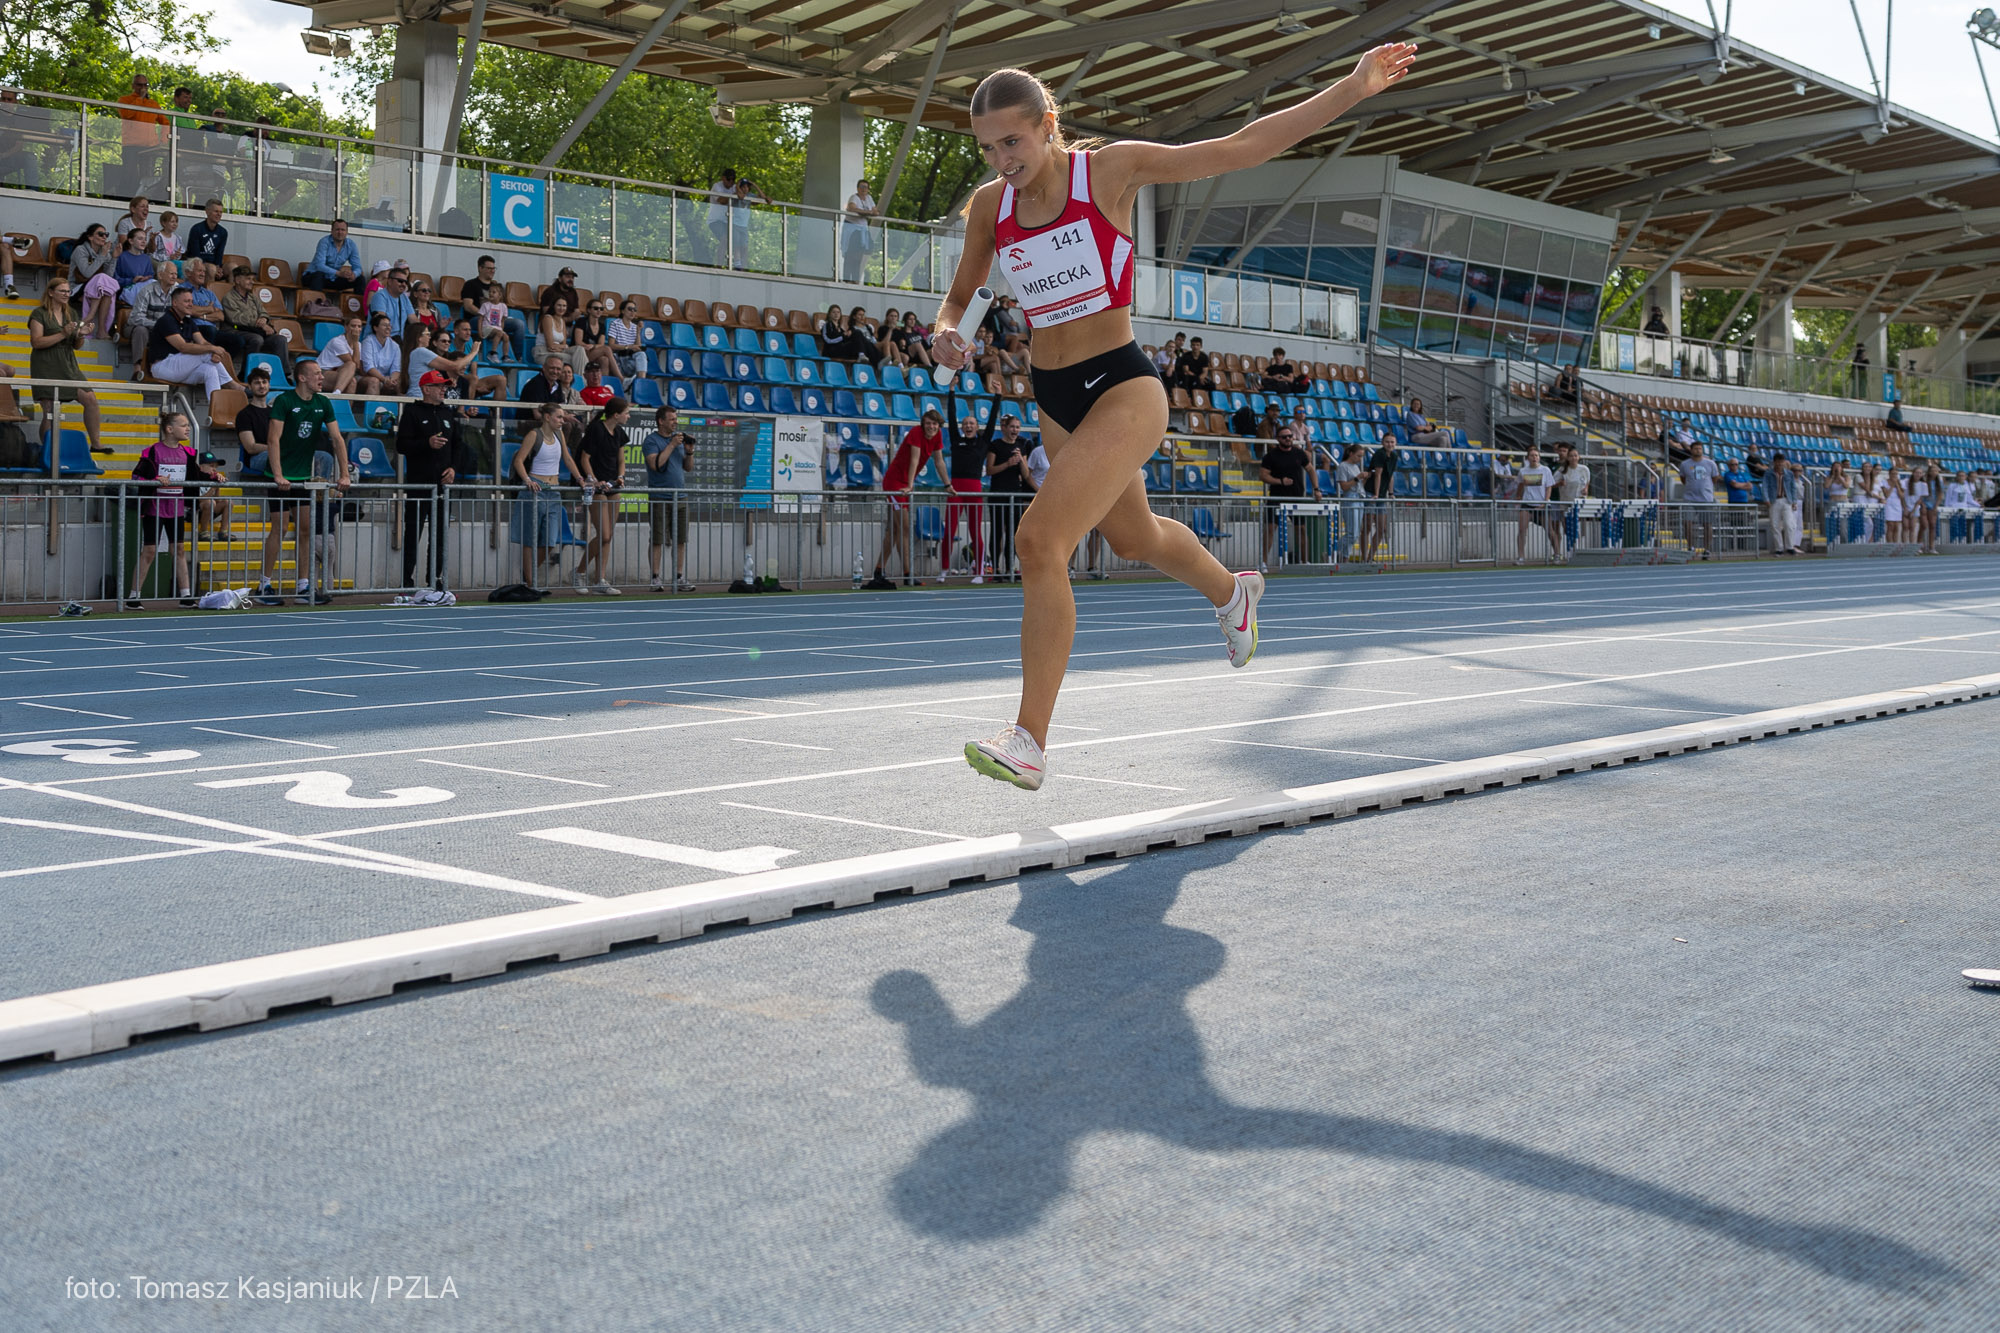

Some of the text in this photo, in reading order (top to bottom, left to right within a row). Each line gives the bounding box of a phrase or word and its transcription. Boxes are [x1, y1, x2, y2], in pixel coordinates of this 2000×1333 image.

[500, 179, 535, 193] SEKTOR
[503, 194, 532, 237] C
[557, 220, 577, 235] WC
[1051, 228, 1084, 251] 141
[1011, 261, 1033, 272] ORLEN
[1022, 264, 1092, 296] MIRECKA
[1181, 284, 1198, 315] D
[1209, 303, 1221, 314] WC
[1046, 304, 1088, 322] LUBLIN 2024
[779, 431, 807, 442] mosir
[1, 737, 201, 765] 3
[194, 770, 456, 809] 2
[518, 826, 799, 875] 1
